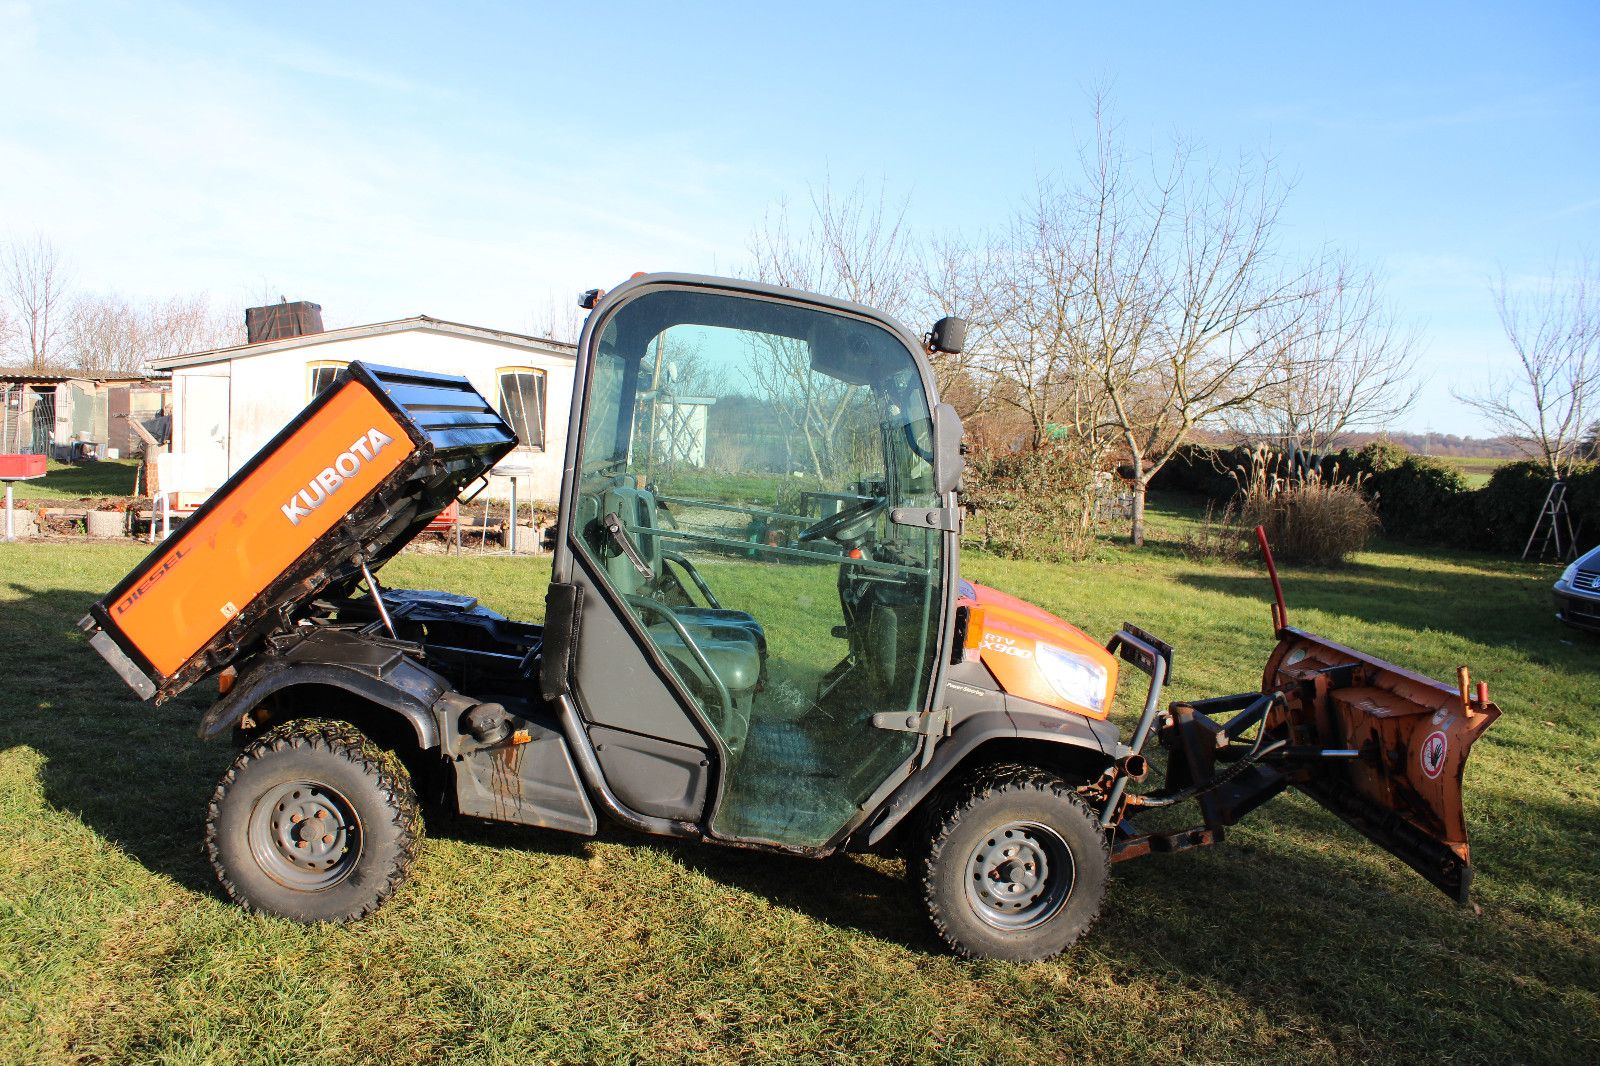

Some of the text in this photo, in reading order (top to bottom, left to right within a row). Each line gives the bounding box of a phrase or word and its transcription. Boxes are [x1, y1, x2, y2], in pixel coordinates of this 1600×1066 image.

[280, 427, 395, 526] KUBOTA
[117, 547, 192, 614] DIESEL
[979, 641, 1032, 659] X900
[984, 632, 1015, 645] RTV
